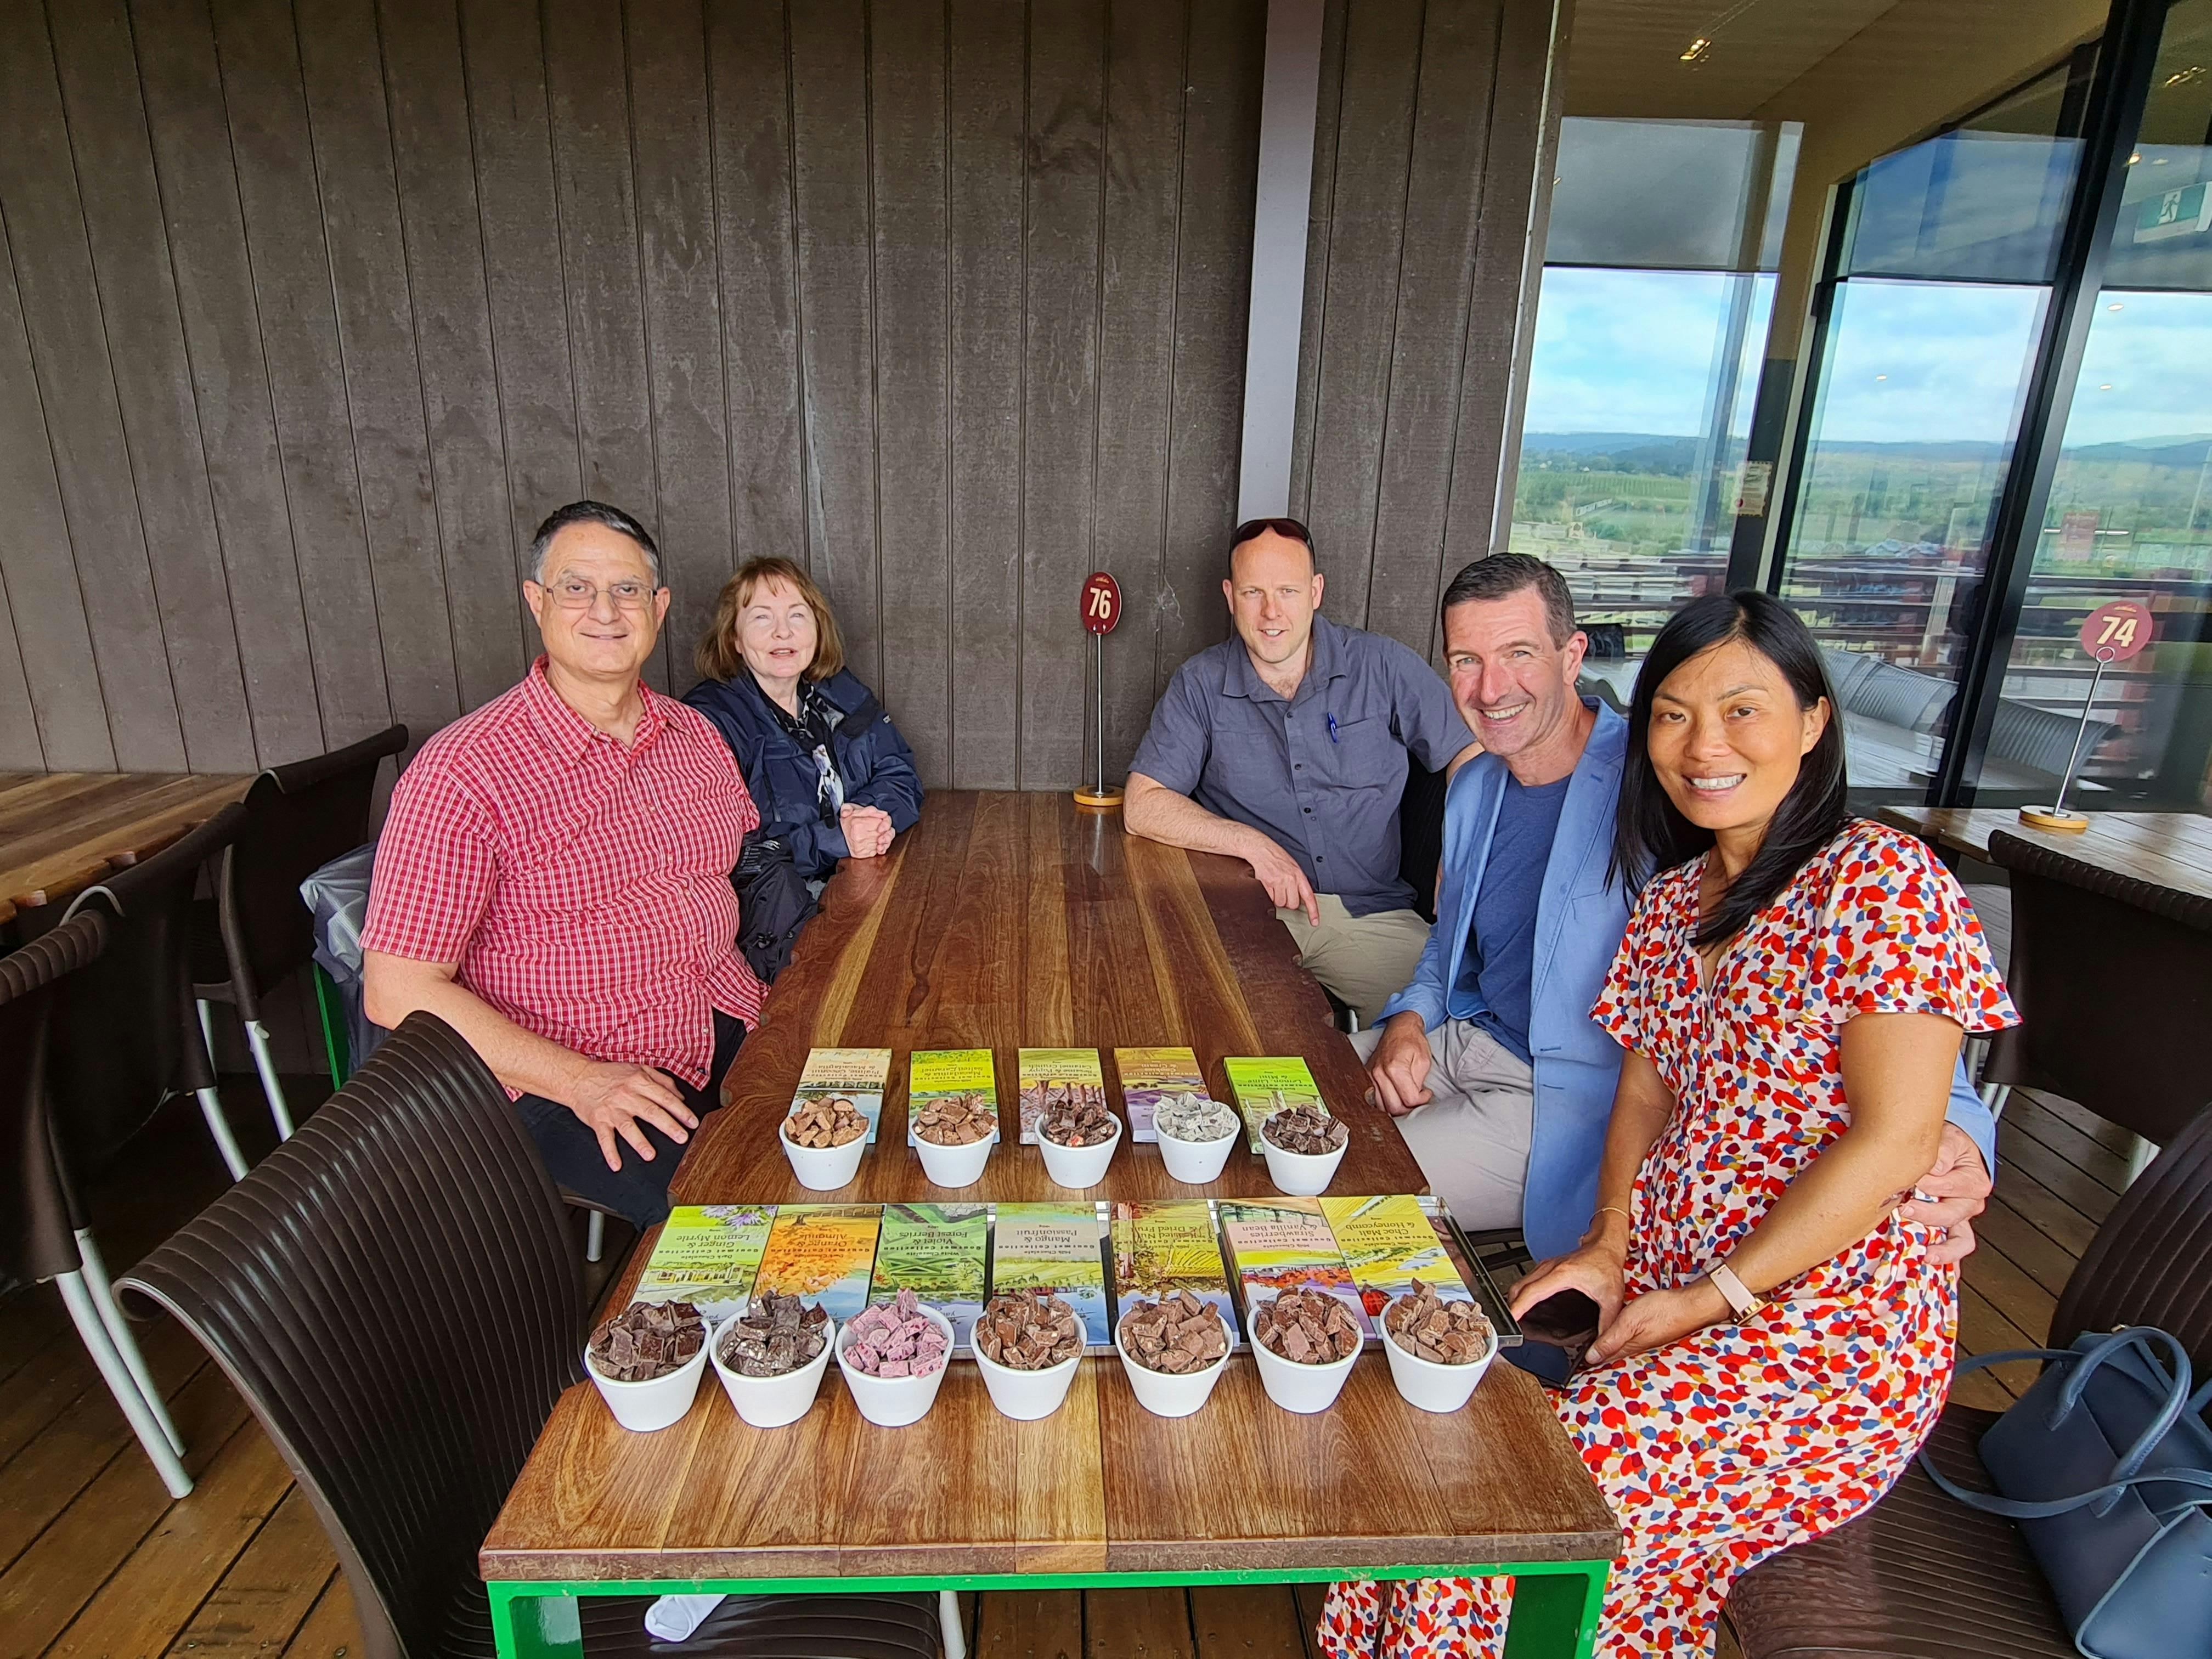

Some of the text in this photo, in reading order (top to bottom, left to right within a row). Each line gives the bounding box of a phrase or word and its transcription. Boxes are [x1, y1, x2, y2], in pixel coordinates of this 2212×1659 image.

[1088, 586, 1111, 619] 76
[2096, 616, 2137, 647] 74
[1345, 1222, 1404, 1230] Honeycomb
